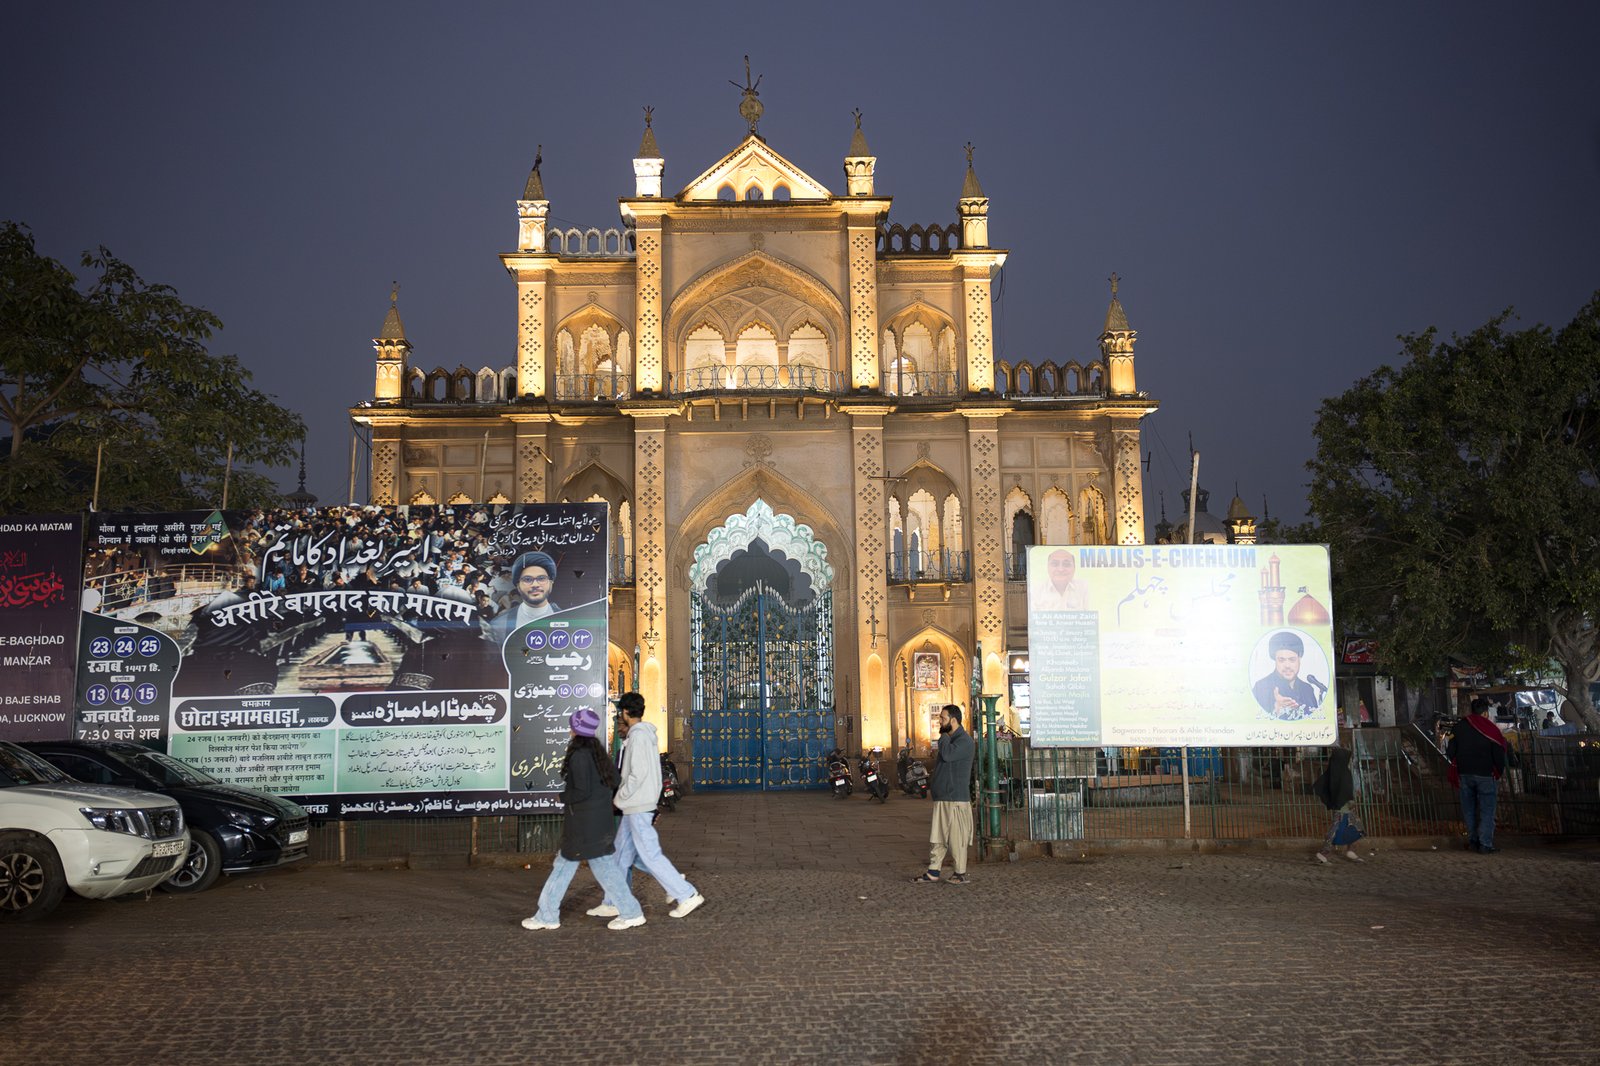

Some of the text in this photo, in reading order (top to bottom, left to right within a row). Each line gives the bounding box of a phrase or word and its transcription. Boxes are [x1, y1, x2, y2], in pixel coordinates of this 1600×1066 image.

[40, 523, 72, 531] MATAM
[135, 534, 157, 544] जवानी
[262, 523, 307, 583] ماتم
[306, 529, 336, 567] کا
[325, 536, 385, 568] بغداد
[1079, 548, 1257, 569] MAJLIS-E-CHEHLUM
[211, 590, 478, 628] असीरे बग़दाद का मातम
[0, 636, 65, 646] E-BAGHDAD
[93, 640, 157, 654] 23 24 25
[530, 635, 543, 645] ۲۵
[3, 656, 51, 666] MANZAR
[87, 660, 124, 673] रजब
[125, 664, 147, 672] 1447
[545, 651, 592, 671] رجب
[1039, 674, 1092, 682] Gulzar Jafari
[90, 687, 154, 701] 13 14 15
[514, 684, 556, 699] جنوری
[5, 696, 31, 704] BAJE
[33, 695, 61, 704] SHAB
[82, 706, 136, 723] जनवरी
[447, 697, 497, 723] چھوٹا
[14, 713, 66, 723] LUCKNOW
[181, 707, 219, 727] छोटा
[220, 708, 305, 728] इमामबाड़ा,
[79, 724, 161, 740] 7:30 बजे शब
[263, 742, 278, 751] किया
[185, 756, 199, 764] रजब
[264, 784, 279, 793] किया
[491, 798, 514, 813] امام
